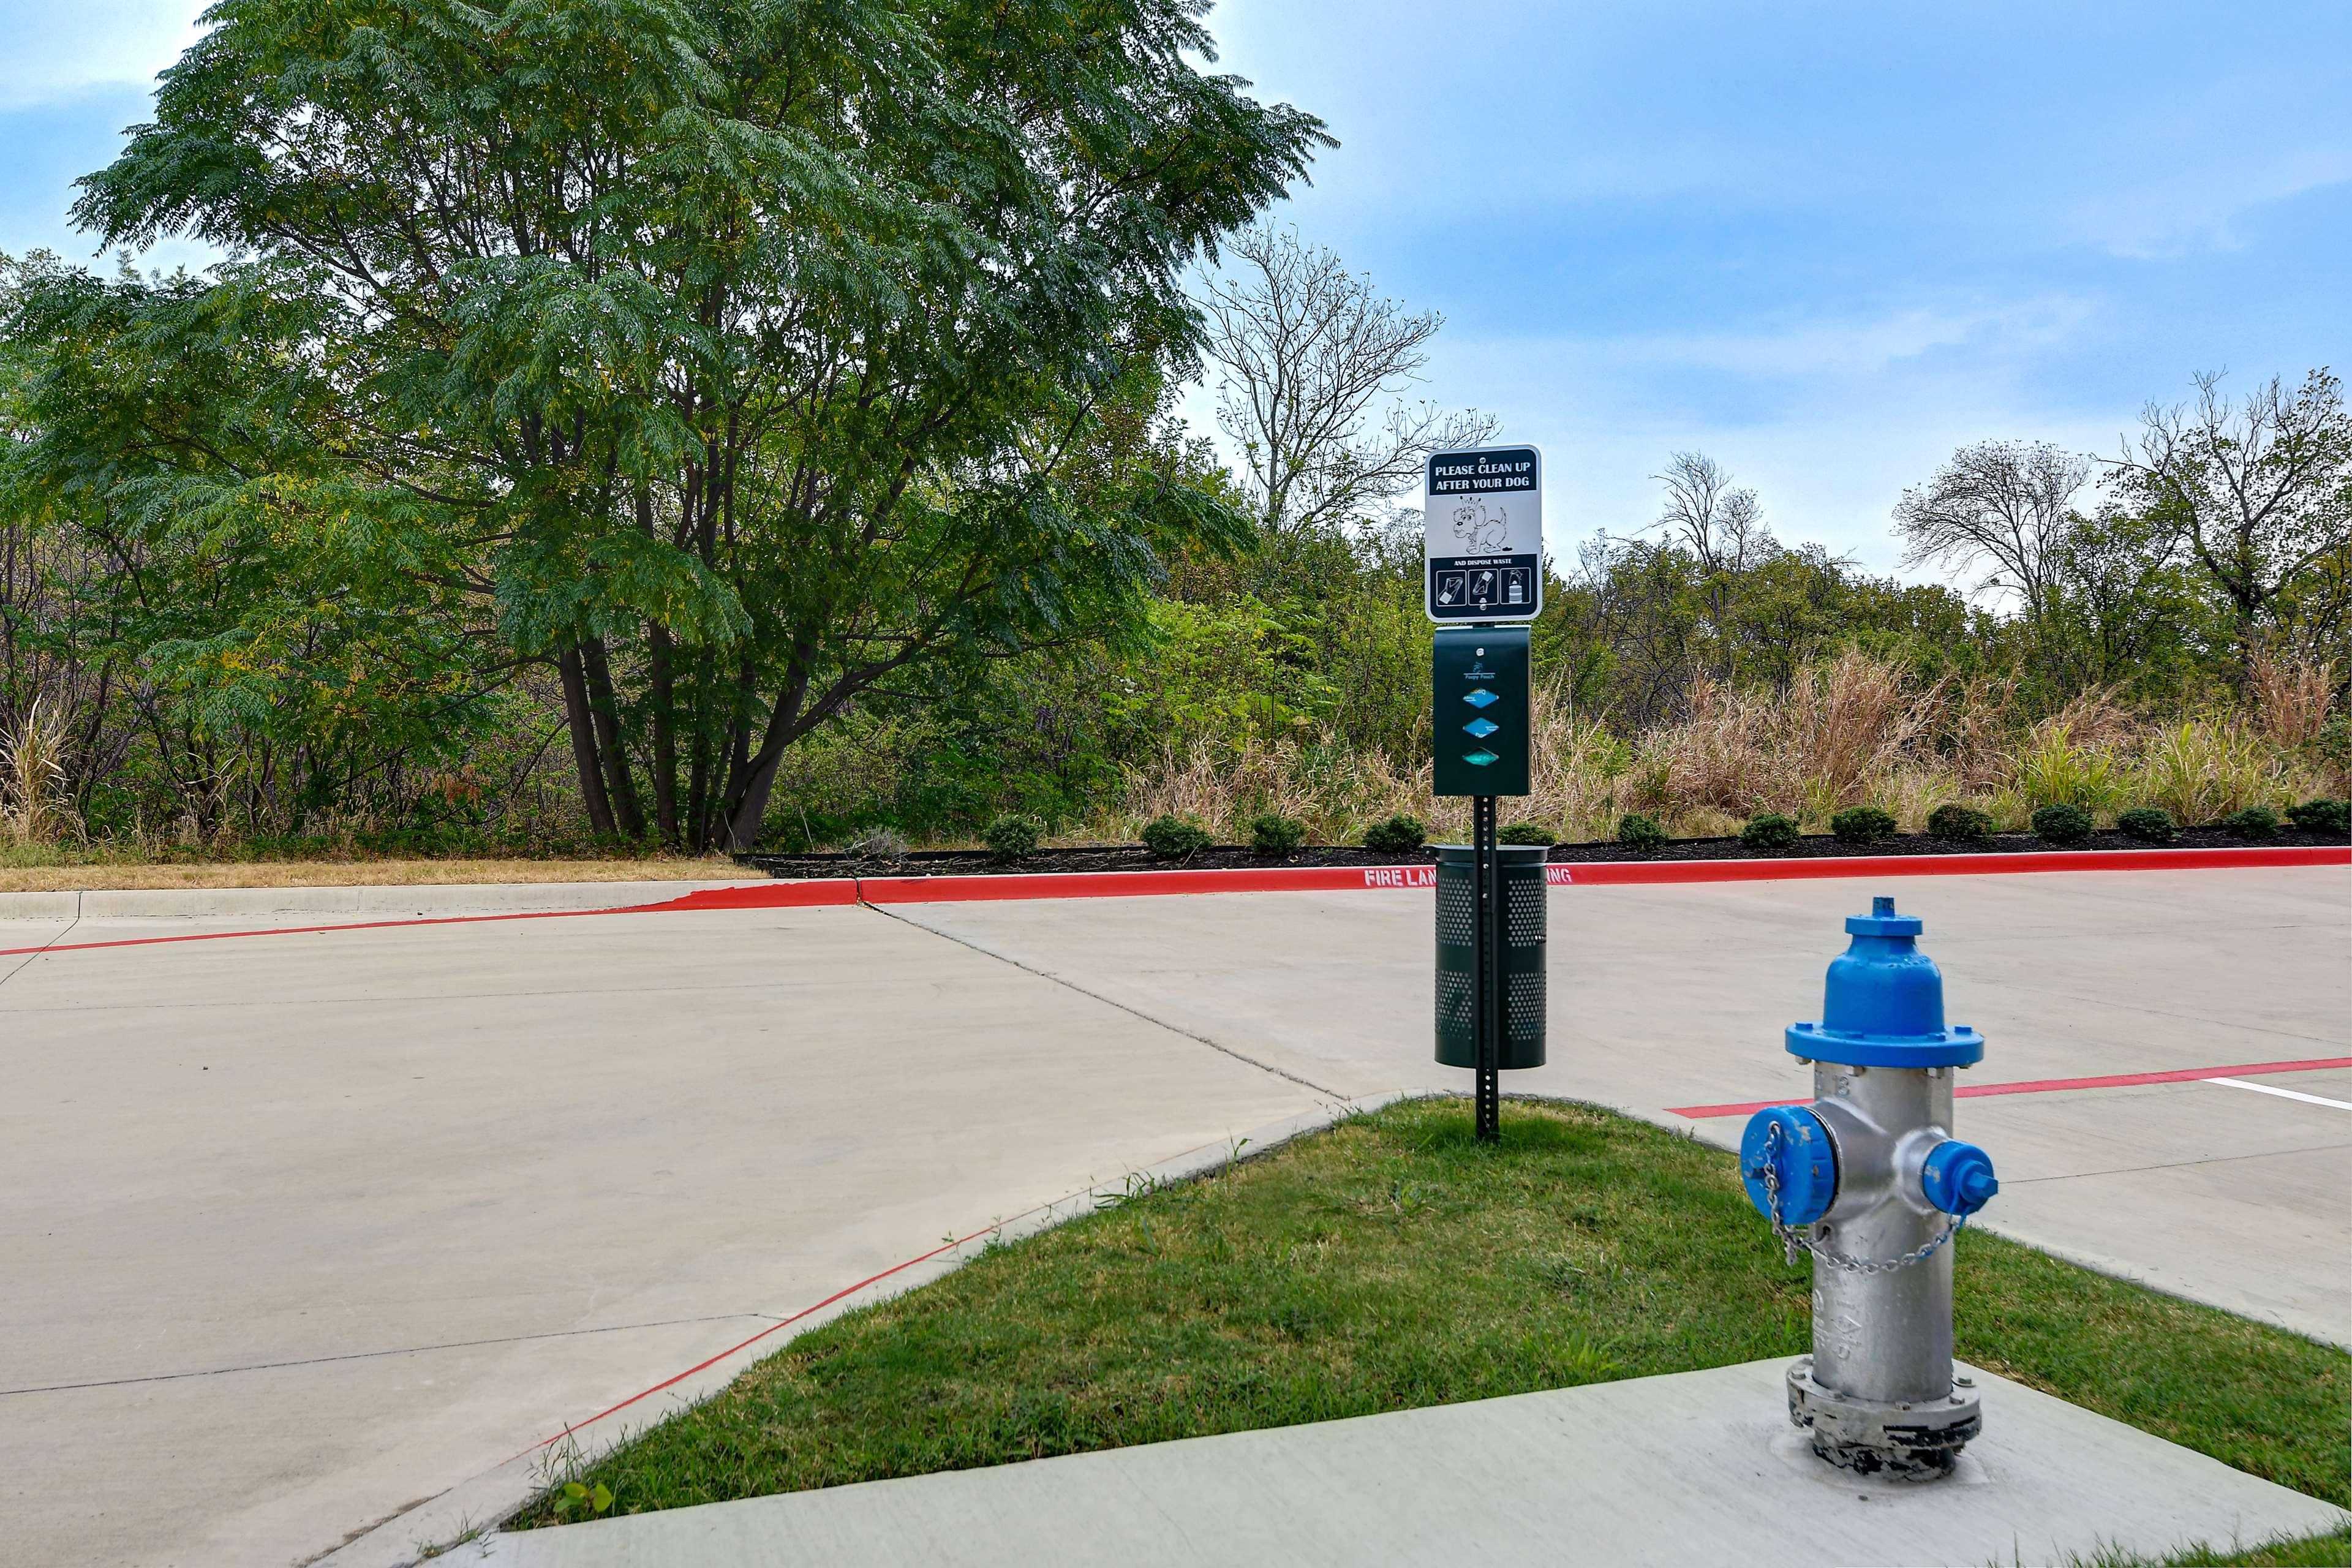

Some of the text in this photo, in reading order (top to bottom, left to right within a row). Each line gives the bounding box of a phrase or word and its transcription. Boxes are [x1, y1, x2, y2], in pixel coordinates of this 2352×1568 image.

[1435, 462, 1531, 476] PLEASE CLEAN UP
[1436, 477, 1529, 490] AFTER YOUR DOG
[1365, 869, 1436, 886] FIRE LAN
